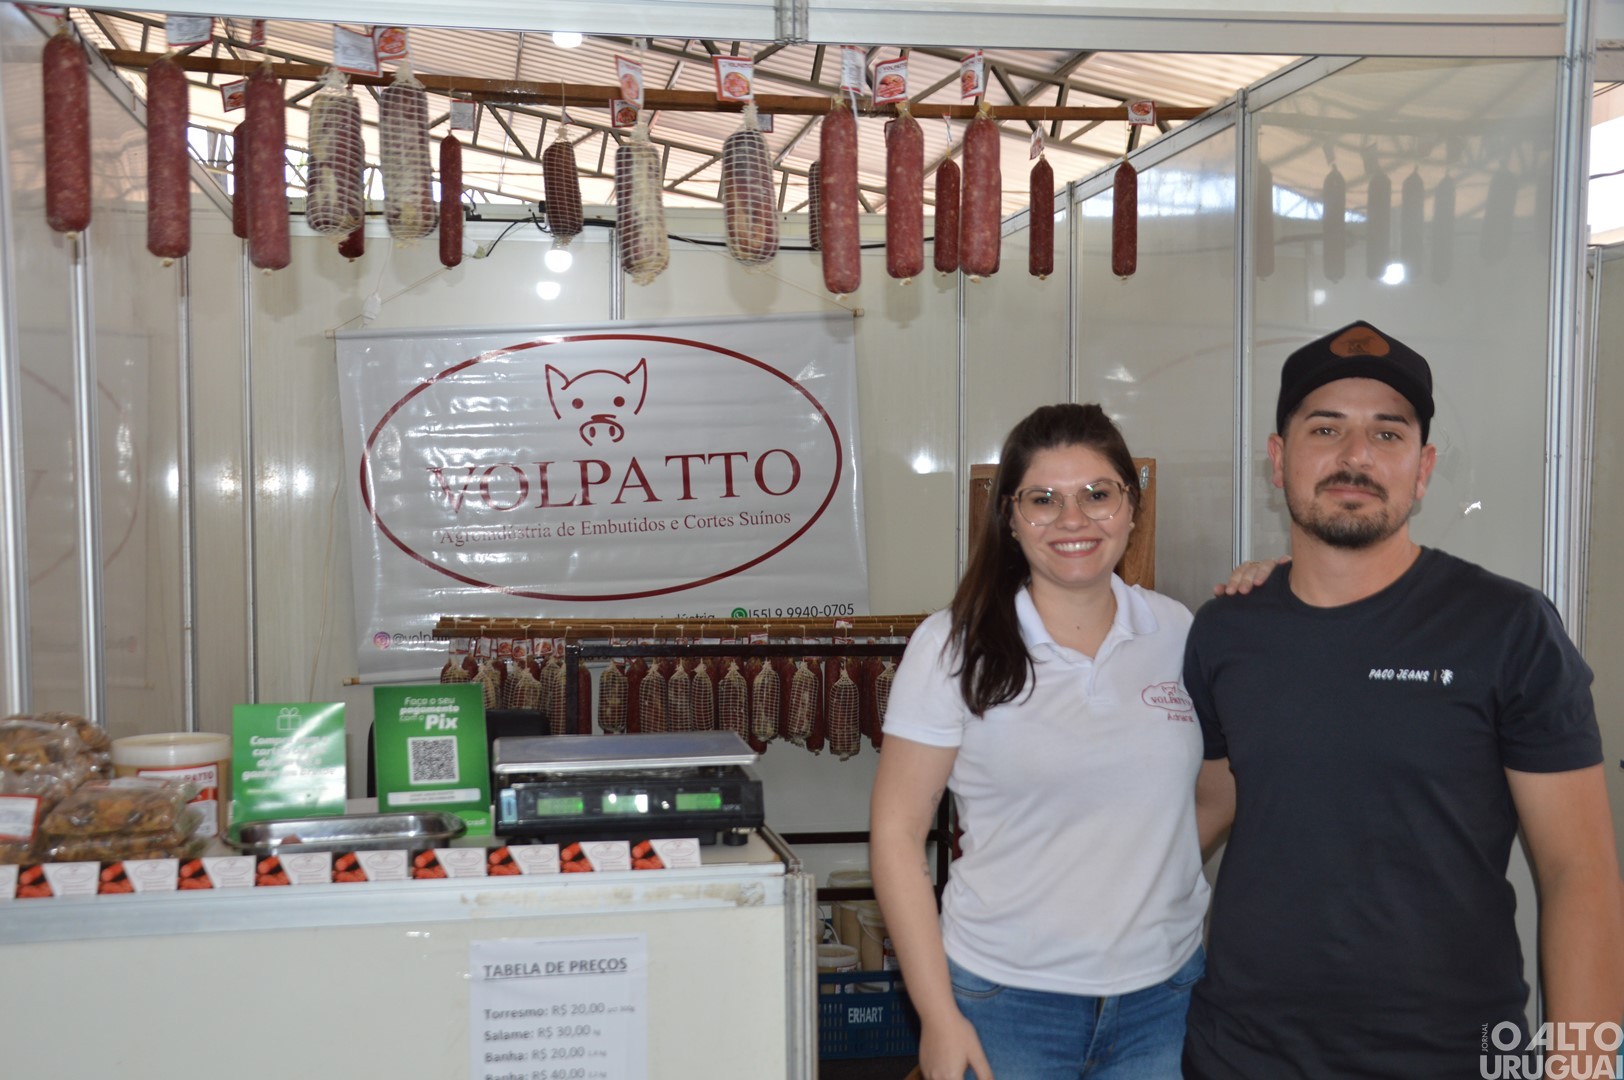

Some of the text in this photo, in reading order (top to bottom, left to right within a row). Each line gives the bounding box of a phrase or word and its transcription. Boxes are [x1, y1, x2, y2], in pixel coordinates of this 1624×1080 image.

[427, 448, 802, 514] VOLPATTO
[557, 522, 575, 537] de
[581, 516, 665, 536] Embutidos
[670, 519, 679, 530] e
[684, 514, 734, 530] Cortes
[739, 510, 791, 526] Suínos
[775, 607, 783, 618] 9
[786, 603, 855, 618] 9940-0705
[1368, 668, 1430, 682] PACO JEANS
[425, 713, 459, 730] Pix
[484, 957, 628, 978] TABELA DE PREÇOS
[484, 1006, 549, 1020] Torresmo:
[551, 1004, 568, 1017] R$
[570, 1002, 605, 1016] 20,00
[848, 1006, 884, 1023] ERHART
[484, 1028, 534, 1042] Salame:
[537, 1026, 553, 1039] R$
[556, 1024, 591, 1038] 30,00
[484, 1050, 528, 1063] Banha:
[531, 1048, 548, 1061] R$
[551, 1046, 586, 1060] 20,00
[531, 1069, 548, 1080] R$
[551, 1067, 586, 1080] 40,00
